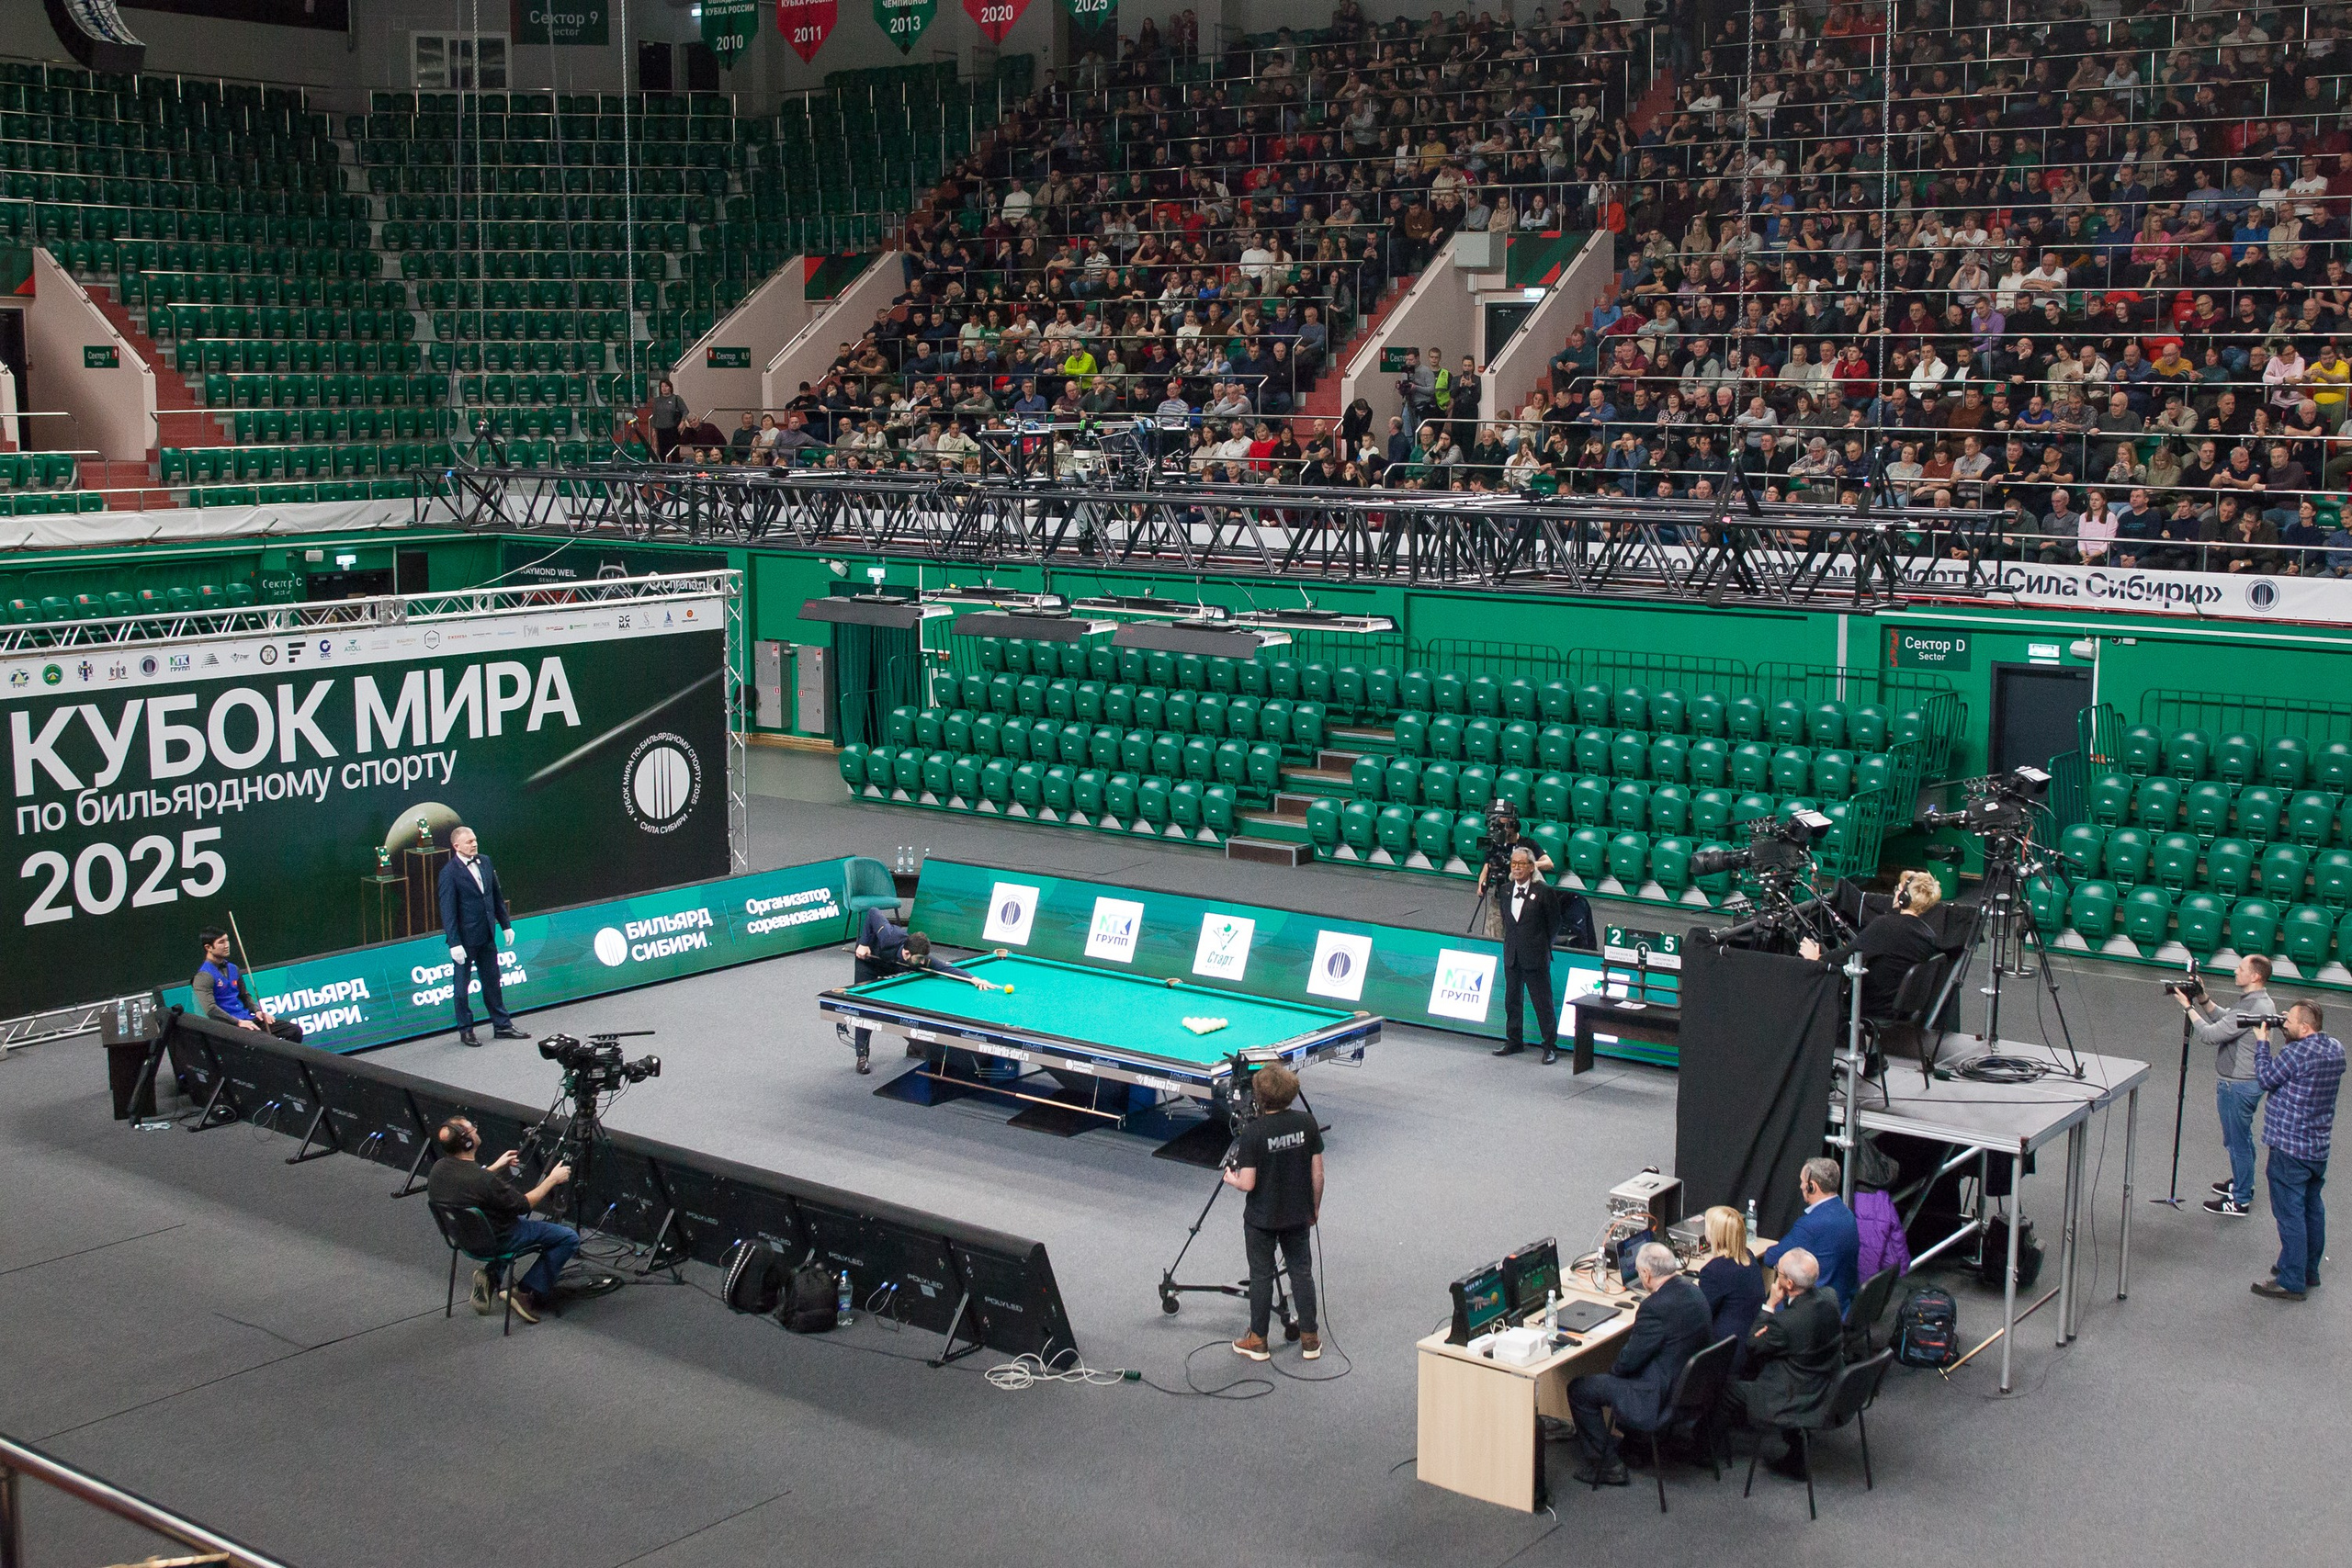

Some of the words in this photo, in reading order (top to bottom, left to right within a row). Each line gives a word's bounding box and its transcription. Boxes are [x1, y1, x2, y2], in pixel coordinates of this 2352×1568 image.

[529, 10, 585, 28] Сектор
[590, 11, 599, 25] 9
[705, 8, 728, 17] КУБКА
[728, 4, 755, 15] РОССИИ
[980, 5, 1014, 24] 2020
[889, 16, 922, 34] 2013
[716, 34, 744, 51] 2010
[794, 26, 822, 43] 2011
[717, 352, 736, 361] Сектор
[2086, 571, 2223, 608] Сибири»
[1905, 636, 1951, 653] Сектор
[1956, 638, 1966, 652] D
[1918, 651, 1947, 661] Sector
[10, 680, 339, 797] КУБОК
[355, 656, 582, 753] МИРА
[639, 732, 692, 750] БИЛЬЯРДНОМУ
[630, 747, 642, 761] ПО
[622, 760, 635, 785] МИРА
[687, 749, 702, 783] СПОРТУ
[17, 804, 67, 836] по
[75, 766, 334, 828] бильярдному
[341, 750, 458, 791] спорту
[622, 786, 636, 816] КУБОК
[691, 783, 701, 806] 2025
[639, 821, 660, 834] СИЛА
[660, 812, 689, 834] СИБИРИ
[22, 827, 228, 926] 2025
[745, 887, 831, 917] Организатор
[626, 908, 714, 941] БИЛЬЯРД
[747, 901, 840, 935] соревнований
[1095, 933, 1128, 947] ГРУПП
[1611, 929, 1622, 945] 2
[1664, 936, 1675, 953] 5
[1207, 951, 1235, 966] Старт
[1640, 946, 1645, 955] 1
[258, 977, 370, 1016] БИЛЬЯРД
[1441, 989, 1479, 1004] ГРУПП
[1267, 1131, 1305, 1150] МАТЧ!
[907, 1273, 944, 1290] POLYLED
[984, 1295, 1023, 1313] POLYLED
